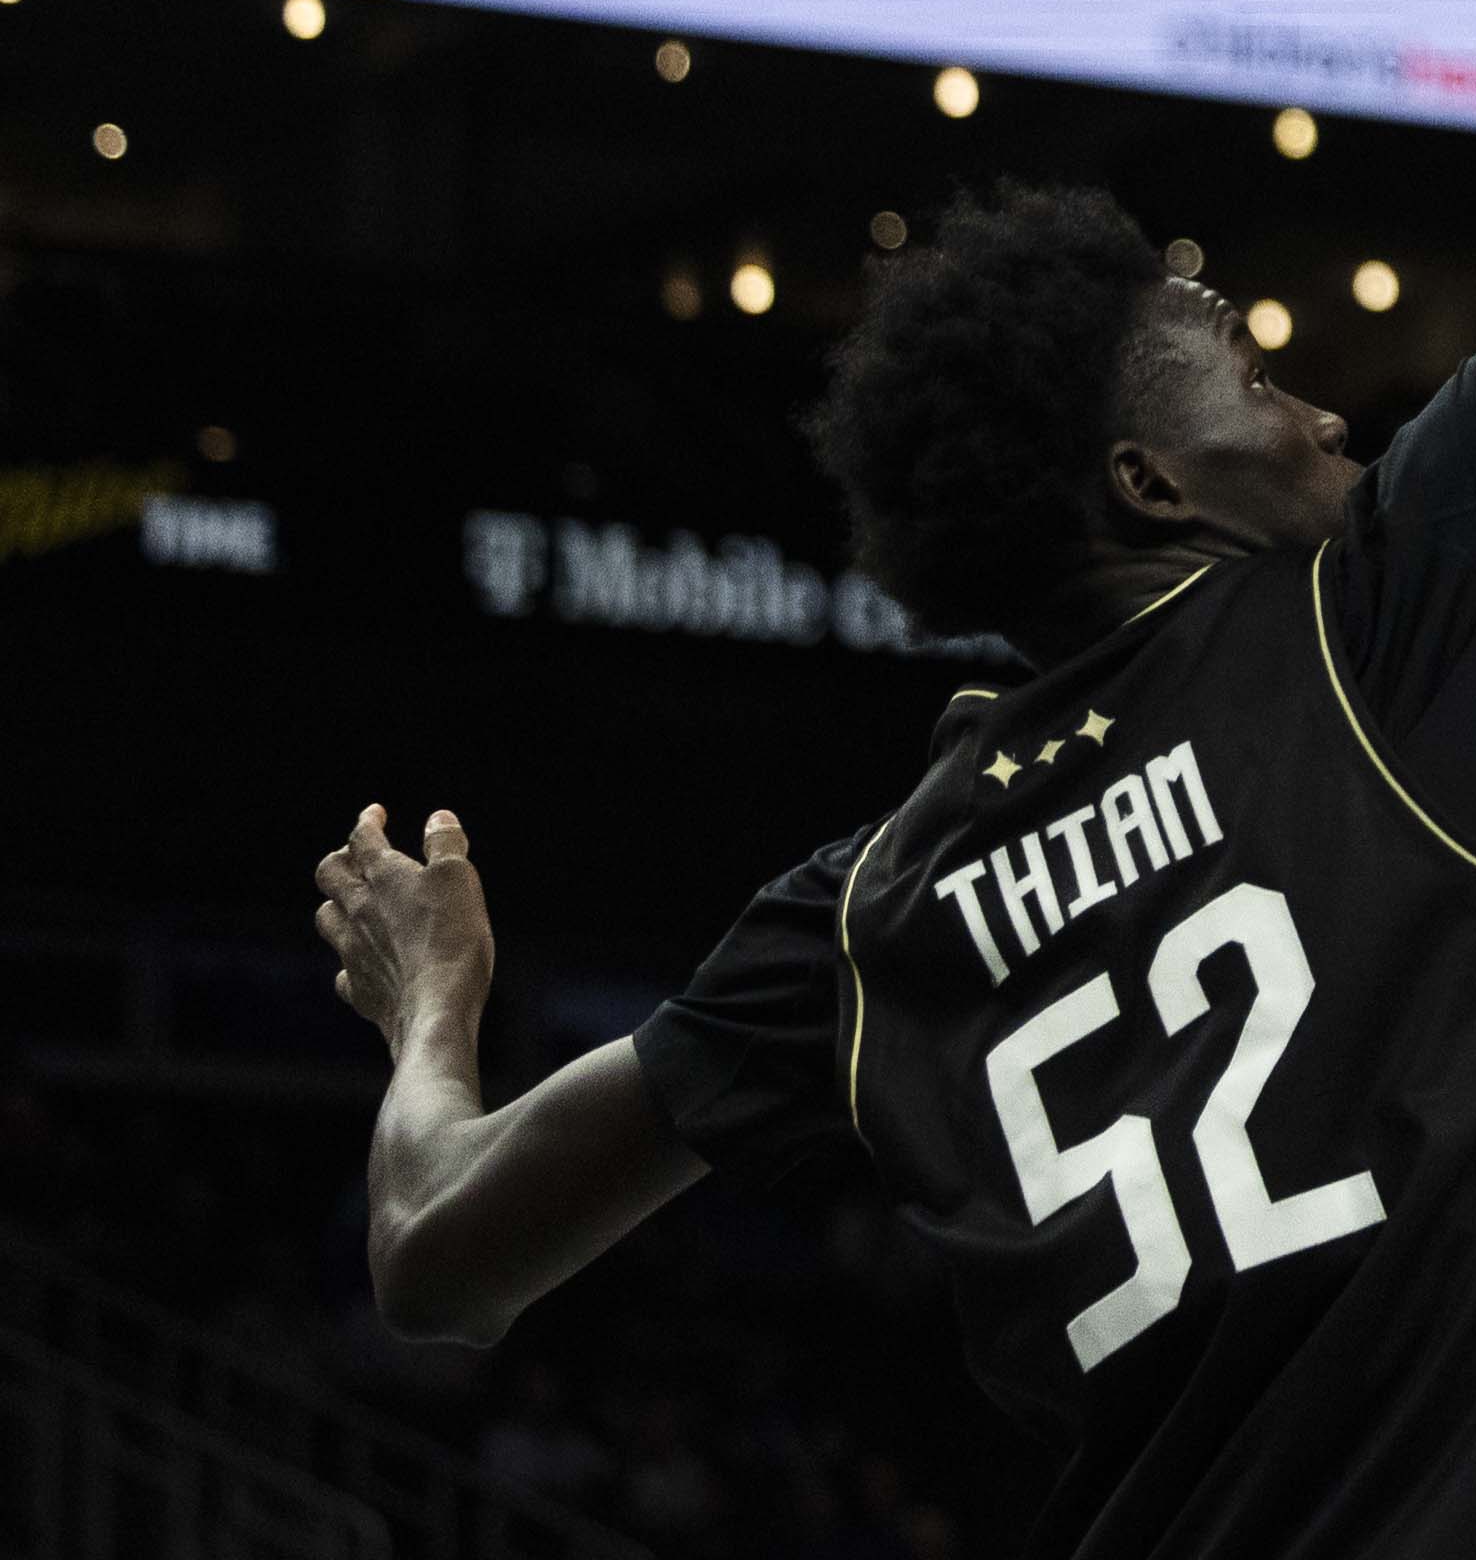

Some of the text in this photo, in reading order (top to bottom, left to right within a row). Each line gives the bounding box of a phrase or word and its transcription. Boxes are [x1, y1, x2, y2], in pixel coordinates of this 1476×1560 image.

[559, 523, 822, 639] Mobile
[933, 740, 1224, 989] THIAM
[985, 882, 1388, 1374] 52
